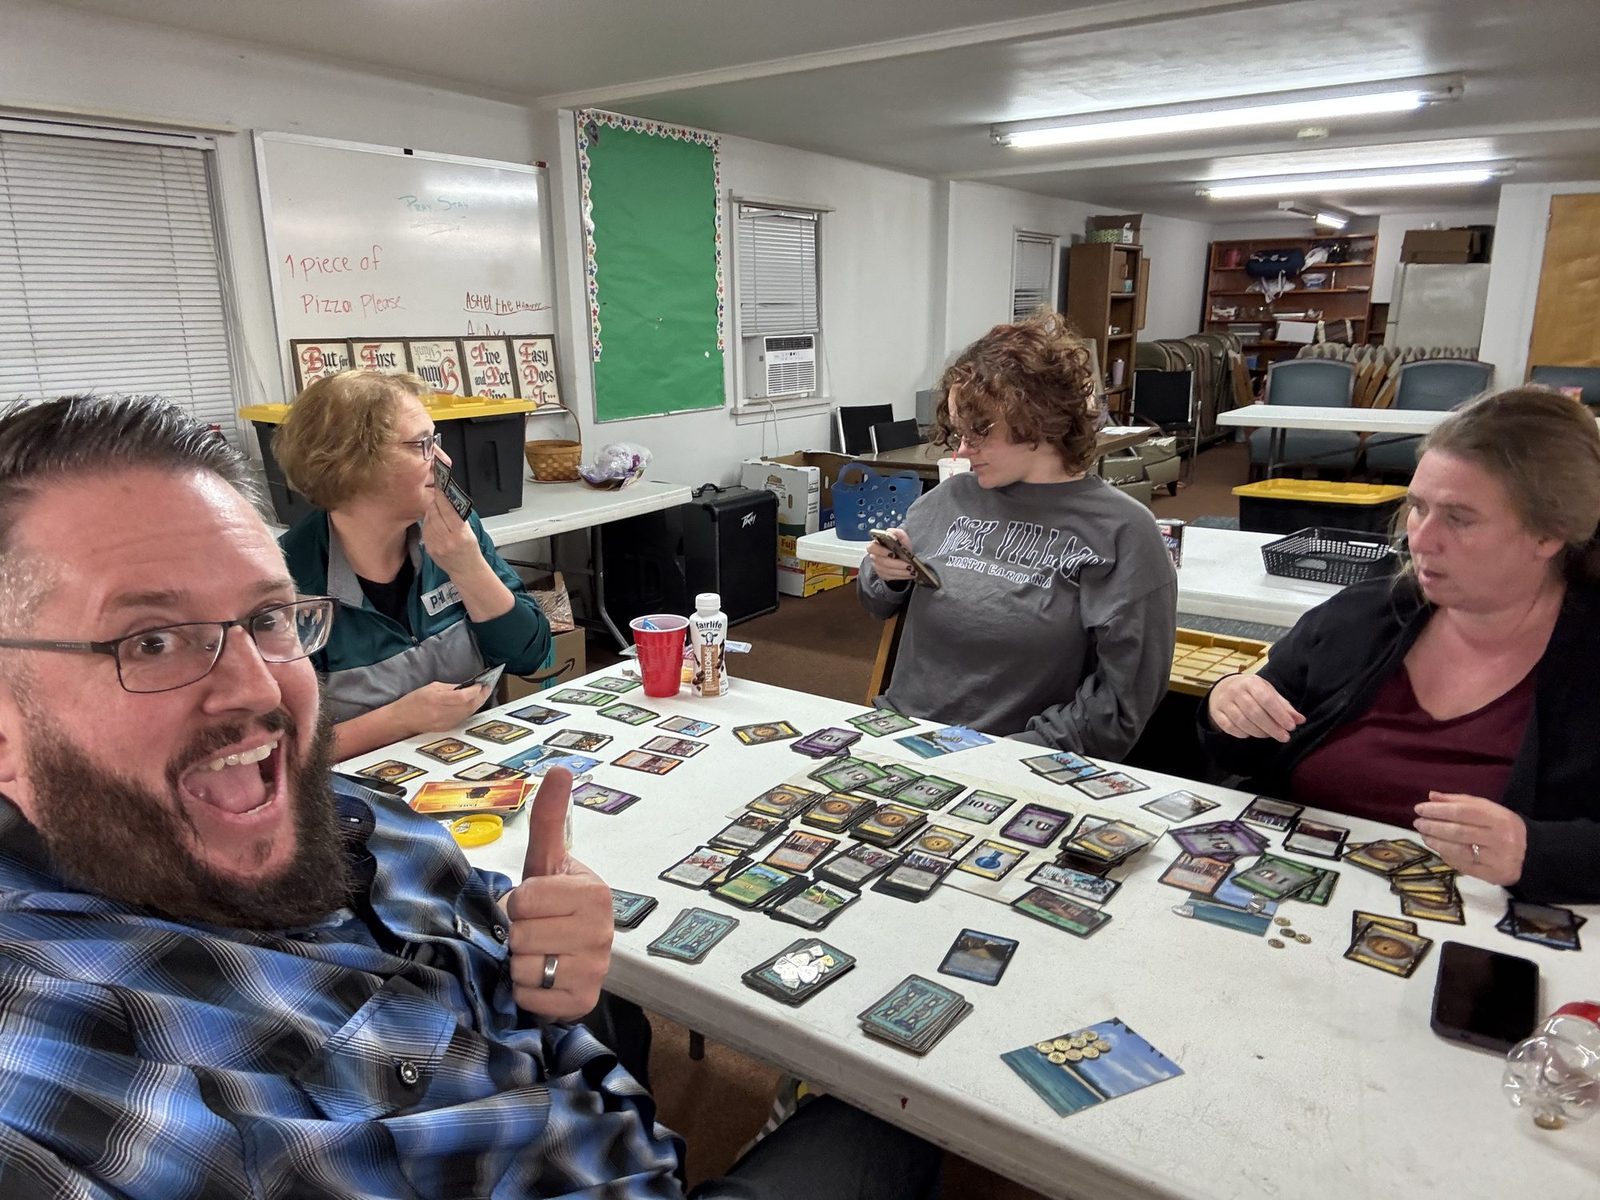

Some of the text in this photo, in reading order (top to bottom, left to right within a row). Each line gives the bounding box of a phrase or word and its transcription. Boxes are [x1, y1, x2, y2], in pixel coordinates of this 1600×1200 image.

[301, 256, 352, 282] piece
[360, 244, 383, 271] of
[360, 294, 403, 317] Please
[360, 344, 398, 369] First
[470, 342, 502, 367] Live
[518, 342, 549, 367] Easy
[523, 364, 555, 385] Does
[696, 621, 723, 630] fairlife
